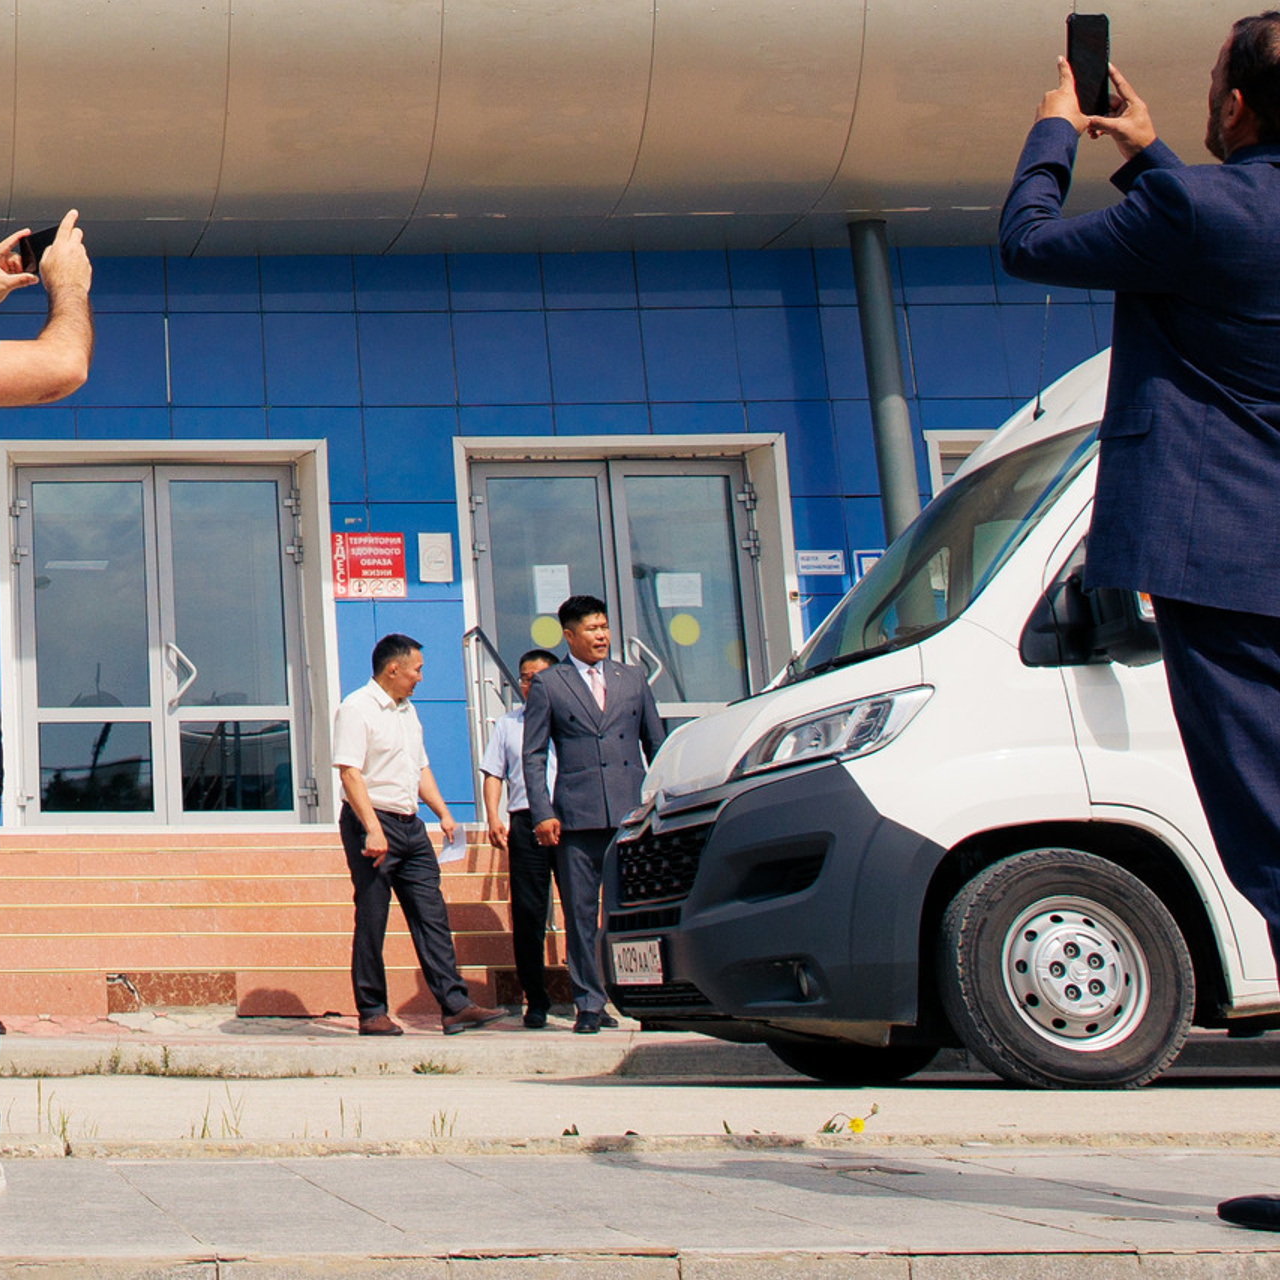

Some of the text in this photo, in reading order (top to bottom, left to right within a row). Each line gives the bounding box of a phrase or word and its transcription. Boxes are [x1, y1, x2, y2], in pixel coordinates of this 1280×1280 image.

[349, 536, 402, 545] ТЕРРИТОРИЯ
[351, 548, 401, 556] ЗДОРОВОГО
[334, 534, 346, 594] ЗДЕСЬ
[360, 558, 393, 566] ОБРАЗА
[361, 569, 392, 577] ЖИЗНИ
